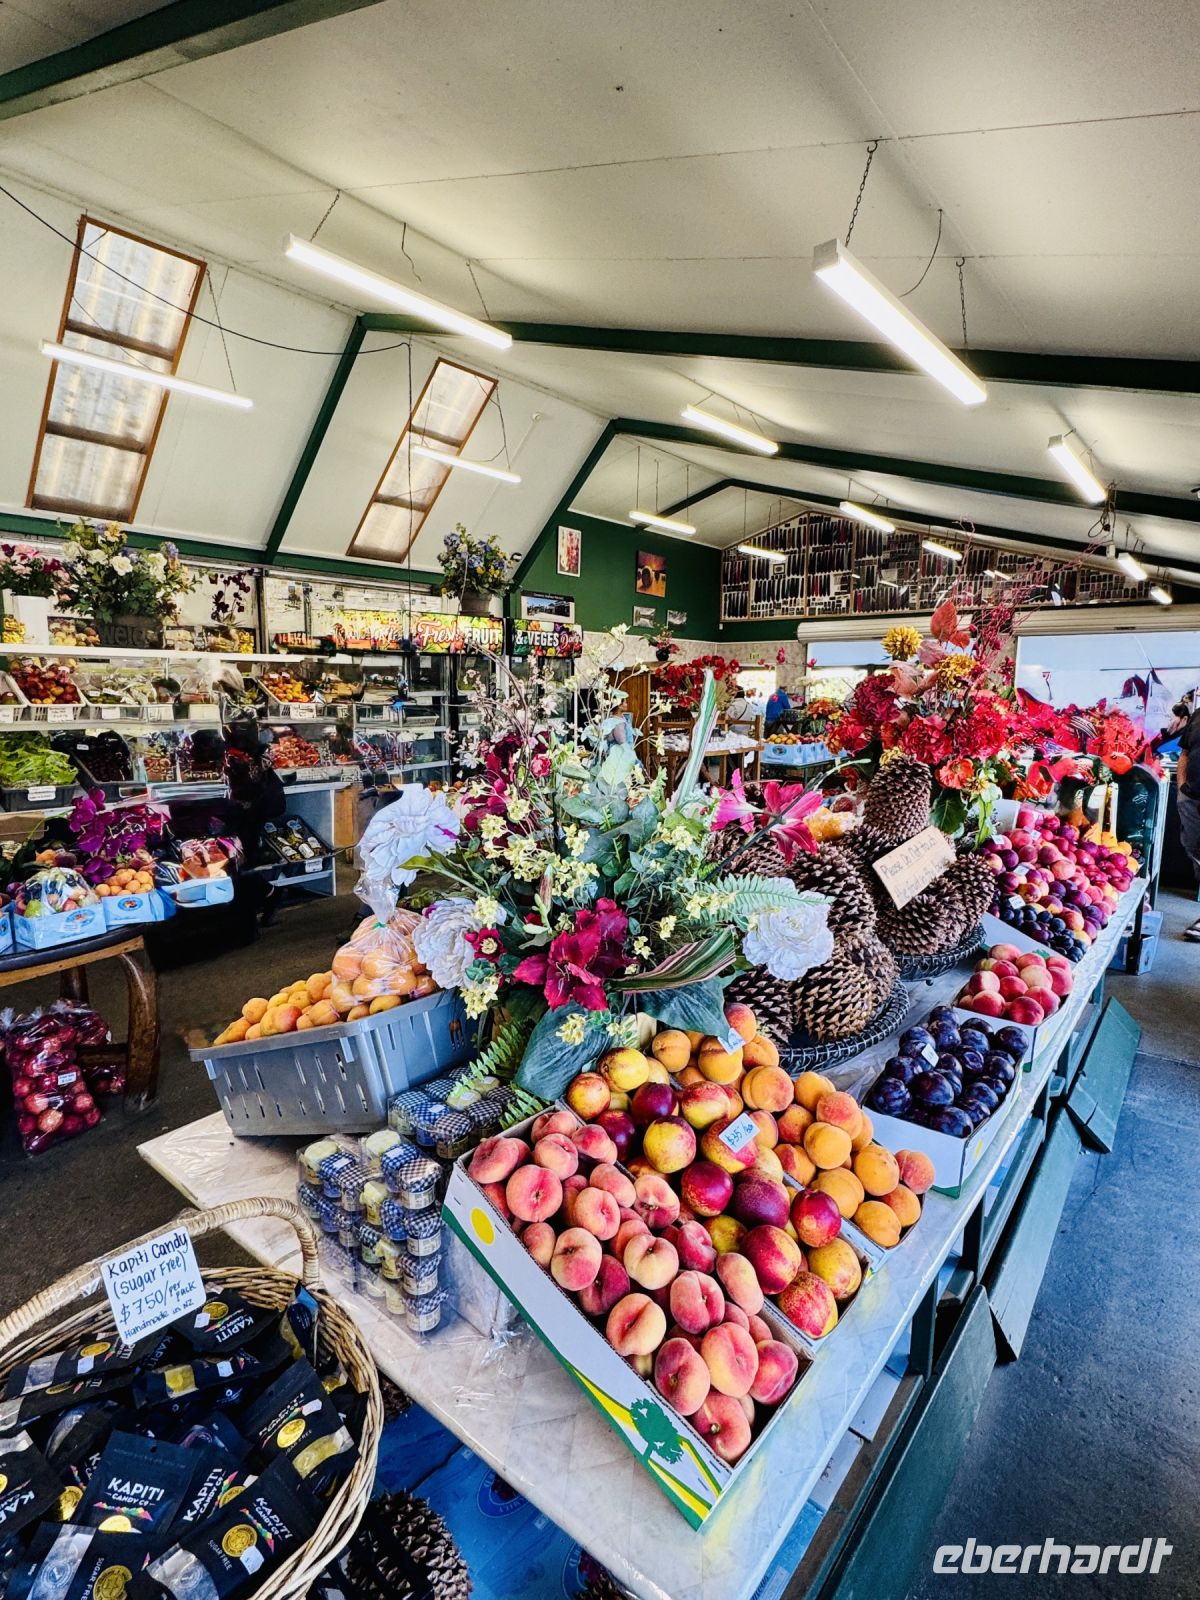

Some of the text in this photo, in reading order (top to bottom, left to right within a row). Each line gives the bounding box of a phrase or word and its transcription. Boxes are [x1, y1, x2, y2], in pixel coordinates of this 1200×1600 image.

[416, 620, 460, 647] Fresh
[464, 627, 500, 645] FRUIT
[527, 631, 560, 647] VEGES
[107, 1232, 189, 1279] Kapiti Candy
[159, 1250, 187, 1277] Free)
[183, 1299, 194, 1310] NZ
[216, 1316, 255, 1344] KAPITI
[107, 1476, 165, 1502] KAPITI
[111, 1493, 140, 1505] CANDY
[182, 1468, 223, 1522] KAPITI
[200, 1486, 218, 1514] CANDY
[255, 1506, 273, 1527] CANDY
[255, 1497, 293, 1540] KAPITI
[207, 1539, 233, 1571] SUGAR FREE
[80, 1557, 105, 1600] SUGAR FRE
